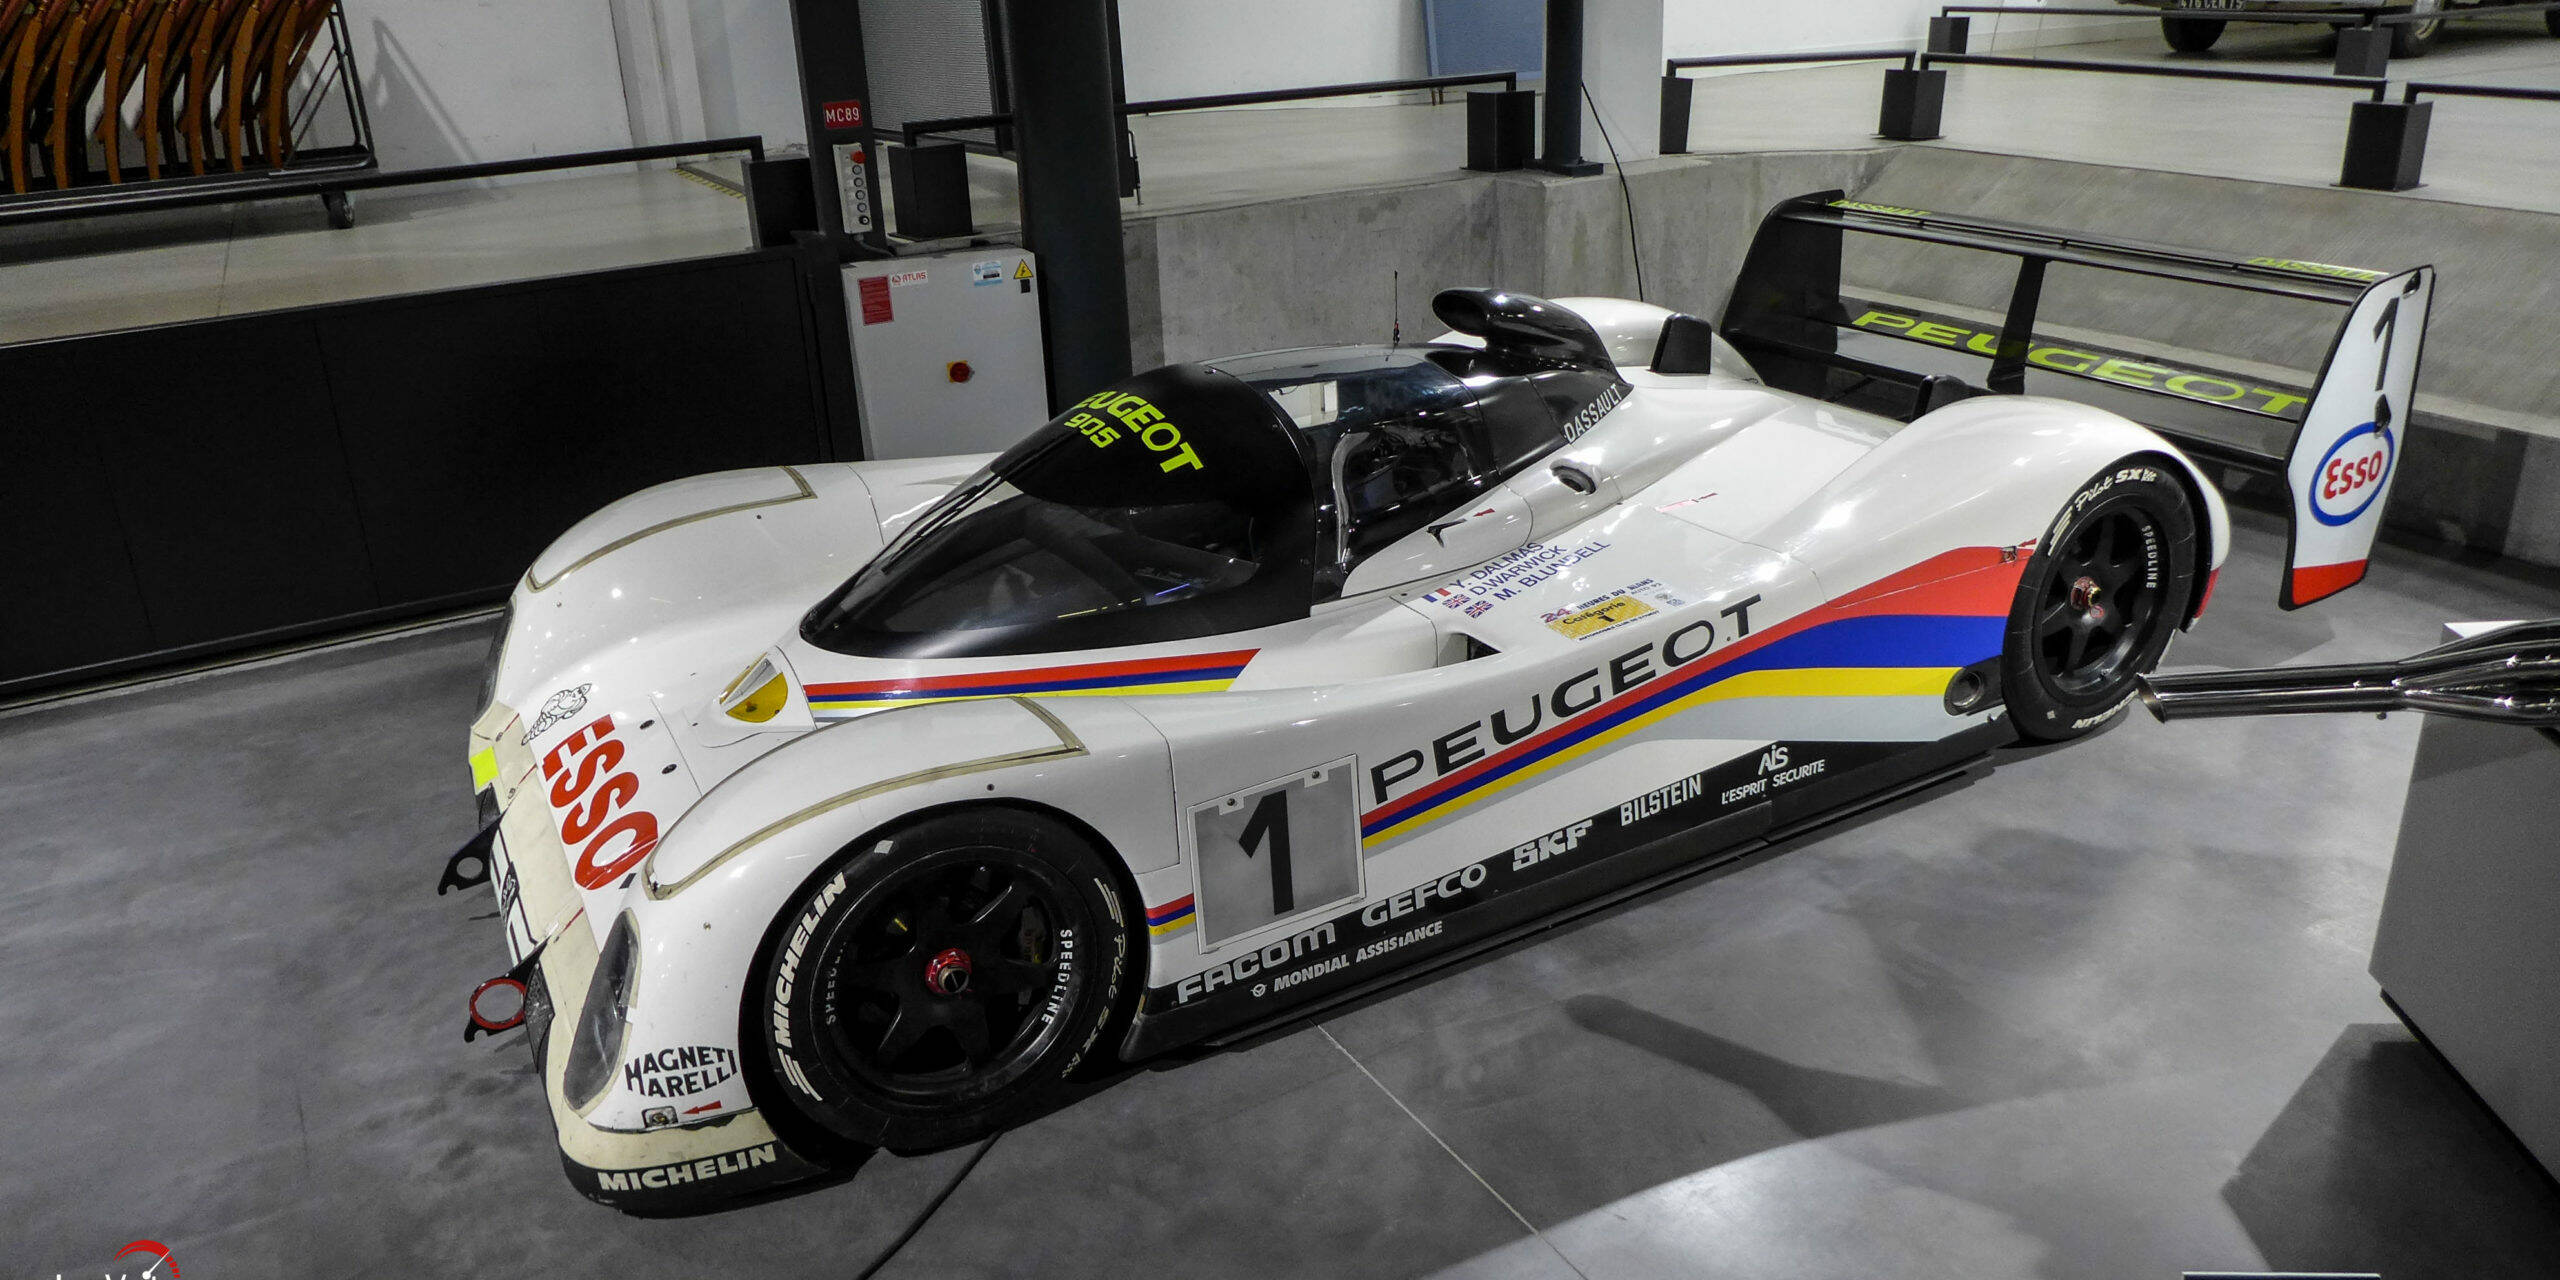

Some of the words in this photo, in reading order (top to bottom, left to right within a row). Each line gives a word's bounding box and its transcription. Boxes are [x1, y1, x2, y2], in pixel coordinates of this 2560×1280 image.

[825, 108, 860, 123] MC89
[902, 271, 926, 283] ATLAS
[2373, 297, 2401, 391] 1
[1064, 412, 1121, 448] 905
[1073, 390, 1204, 473] EUGEOT
[1563, 383, 1622, 443] DASSAULT
[1470, 542, 1544, 580] DALMAS
[1493, 588, 1522, 601] M.
[1518, 541, 1611, 588] BLUNDELL
[2141, 525, 2158, 589] SPEEDLINE
[1370, 594, 1762, 806] PEUGEOT
[542, 714, 659, 891] ESSO
[1620, 773, 1702, 826] BILSTEIN
[1721, 778, 1768, 805] L'ESPRIT
[1772, 759, 1825, 788] SECURITE
[1238, 789, 1295, 915] 1
[1512, 819, 1593, 872] SKF
[1361, 864, 1487, 927] GEFCO
[773, 871, 847, 1049] MICHELIN
[1041, 928, 1073, 1024] SPEEDLINE
[1273, 953, 1350, 992] MONDIAL
[624, 1045, 738, 1090] MAGNETI
[624, 1055, 738, 1098] MARELLI
[598, 1144, 777, 1192] MICHELIN
